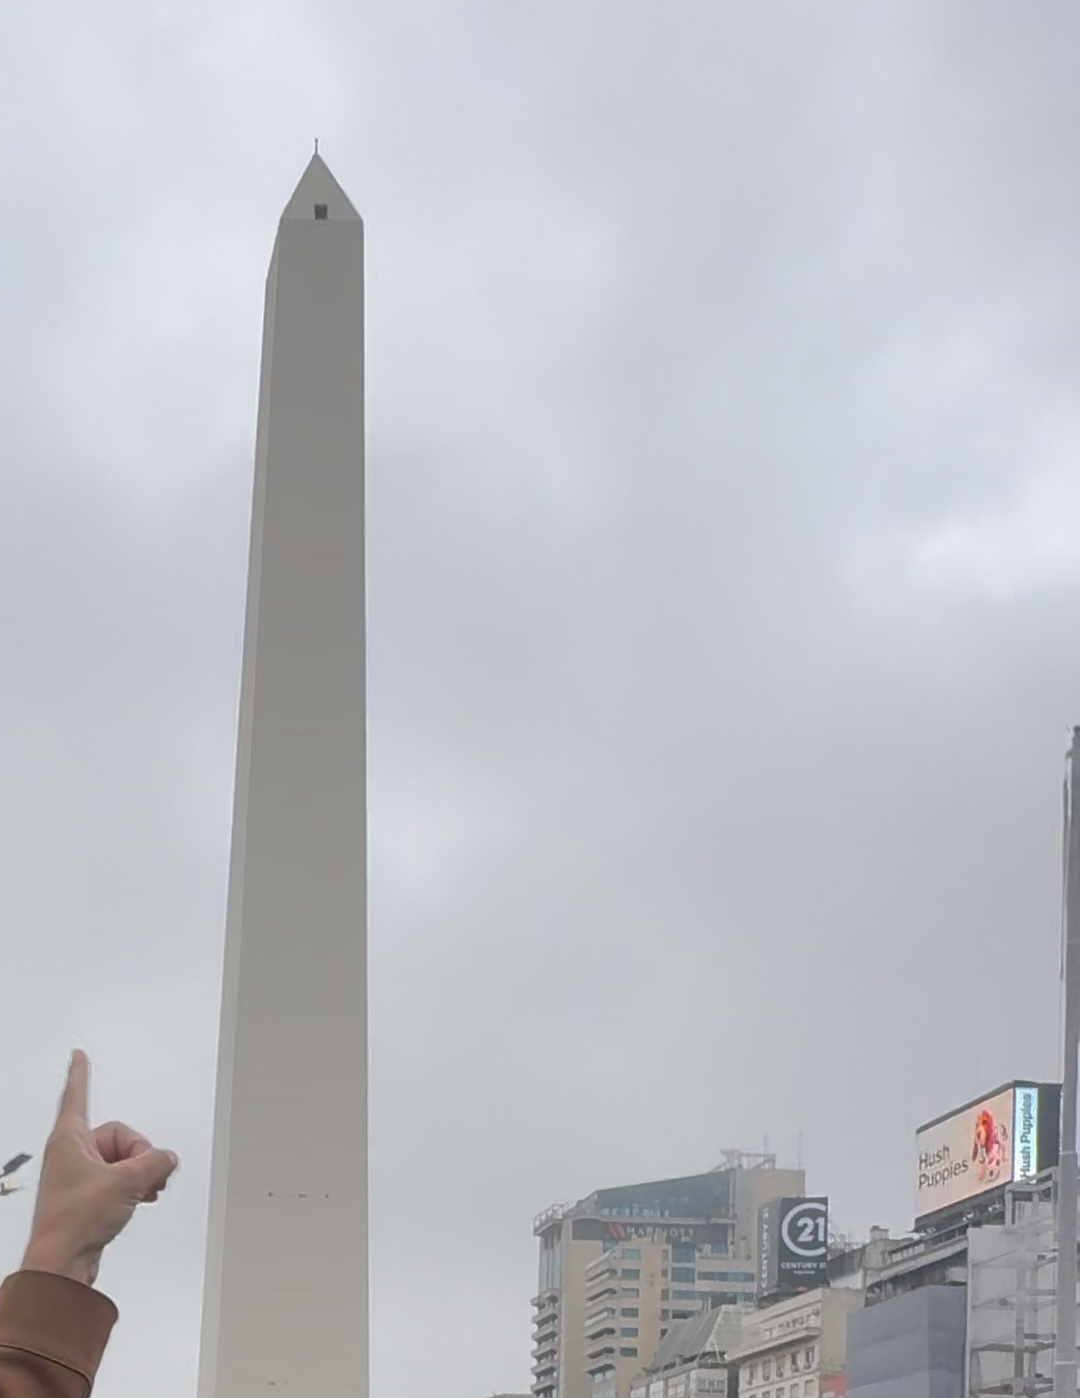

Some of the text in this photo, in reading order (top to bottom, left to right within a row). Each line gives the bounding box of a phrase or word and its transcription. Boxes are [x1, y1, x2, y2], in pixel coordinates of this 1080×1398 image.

[1020, 1093, 1033, 1178] Hush Puppies
[919, 1145, 950, 1170] Hush
[919, 1160, 969, 1189] Puppies
[797, 1217, 825, 1242] 21
